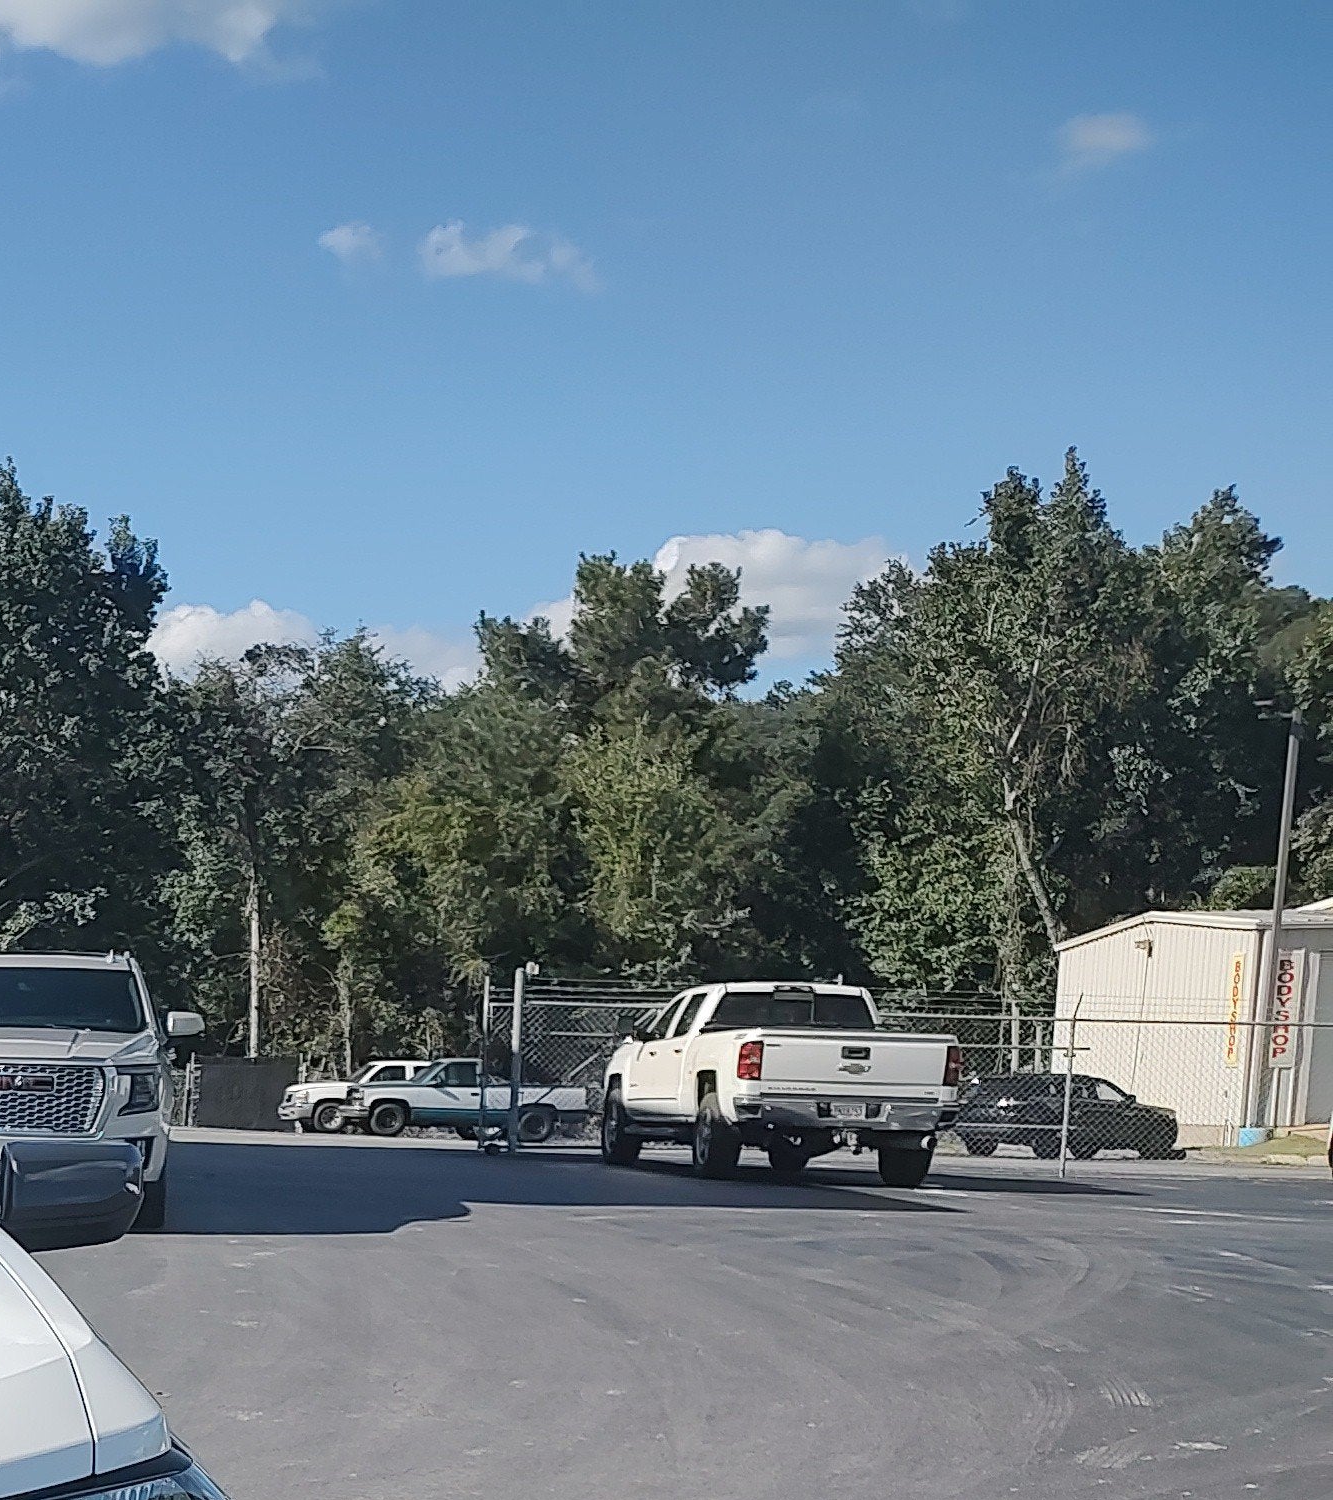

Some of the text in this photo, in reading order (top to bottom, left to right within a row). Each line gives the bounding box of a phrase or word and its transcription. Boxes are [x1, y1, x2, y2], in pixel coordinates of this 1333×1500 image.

[1228, 961, 1241, 1059] BODY SHOP
[1276, 960, 1294, 1007] BODY
